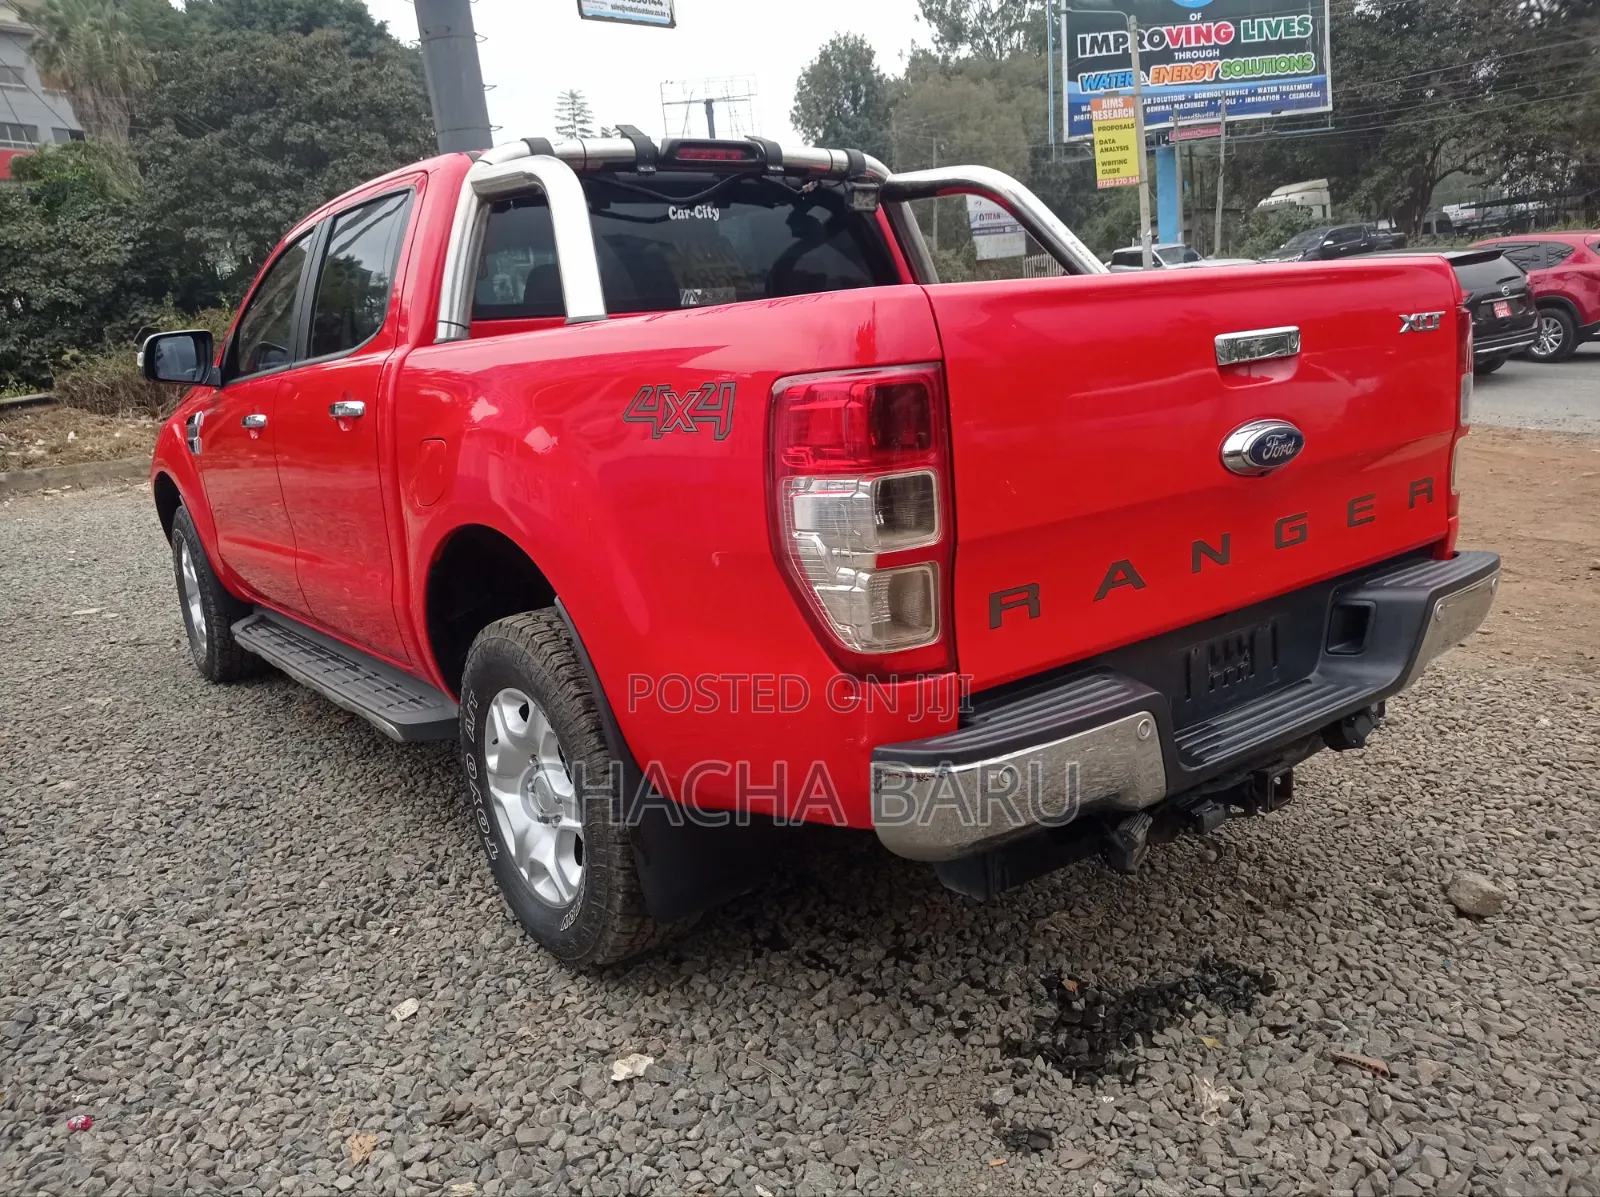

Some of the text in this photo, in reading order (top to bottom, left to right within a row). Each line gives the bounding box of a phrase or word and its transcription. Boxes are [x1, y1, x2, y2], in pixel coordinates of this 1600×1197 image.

[1189, 12, 1203, 22] OF
[1077, 15, 1313, 58] IMPROVING LIVES
[1174, 48, 1220, 61] THROUGH
[1078, 68, 1135, 94] WATER
[1149, 61, 1220, 86] ENERGY
[1220, 52, 1316, 79] SOLUTIONS
[1153, 94, 1186, 104] SOLUTIONS
[1225, 88, 1249, 98] SERVICE
[1257, 85, 1278, 94] WATER
[1279, 83, 1313, 93] TREATMENT
[1102, 97, 1124, 109] AIMS
[1146, 104, 1173, 113] GENERAL
[1174, 101, 1209, 110] MACHINERY
[1217, 98, 1237, 106] POLS
[1245, 94, 1280, 104] IRRIGATION
[1288, 91, 1320, 100] CHEMICALS
[1092, 108, 1135, 121] RESEARCH
[1097, 123, 1135, 132] PROPOSALS
[1099, 138, 1116, 146] DATA
[1099, 145, 1130, 154] ANALYSIS
[1101, 159, 1128, 167] WRITING
[1101, 167, 1121, 175] GUIDE
[668, 204, 720, 222] Car-City
[1399, 310, 1446, 333] XLT
[1262, 432, 1296, 461] Ford
[988, 476, 1434, 630] RANGER
[466, 752, 500, 861] TOYO
